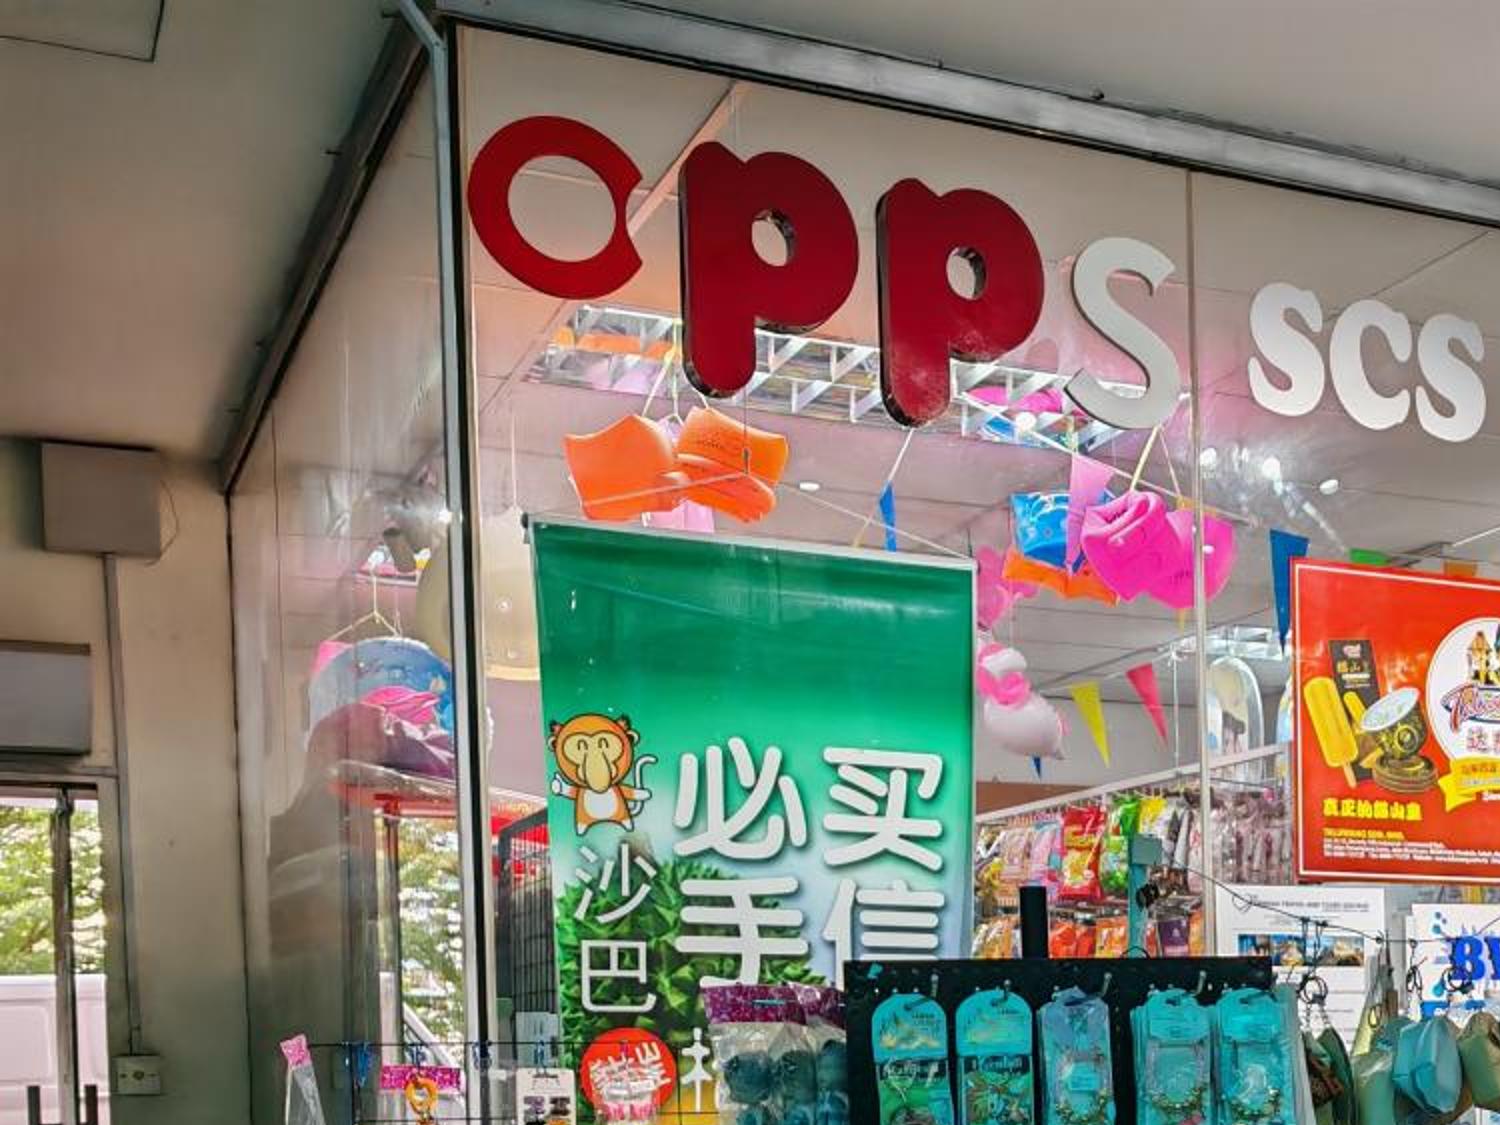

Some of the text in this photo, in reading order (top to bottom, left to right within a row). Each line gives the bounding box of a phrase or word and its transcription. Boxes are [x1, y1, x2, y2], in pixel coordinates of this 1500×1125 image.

[1247, 281, 1486, 443] SCS
[672, 736, 944, 873] 必买
[574, 842, 658, 1014] 沙巴
[674, 875, 946, 986] 手信
